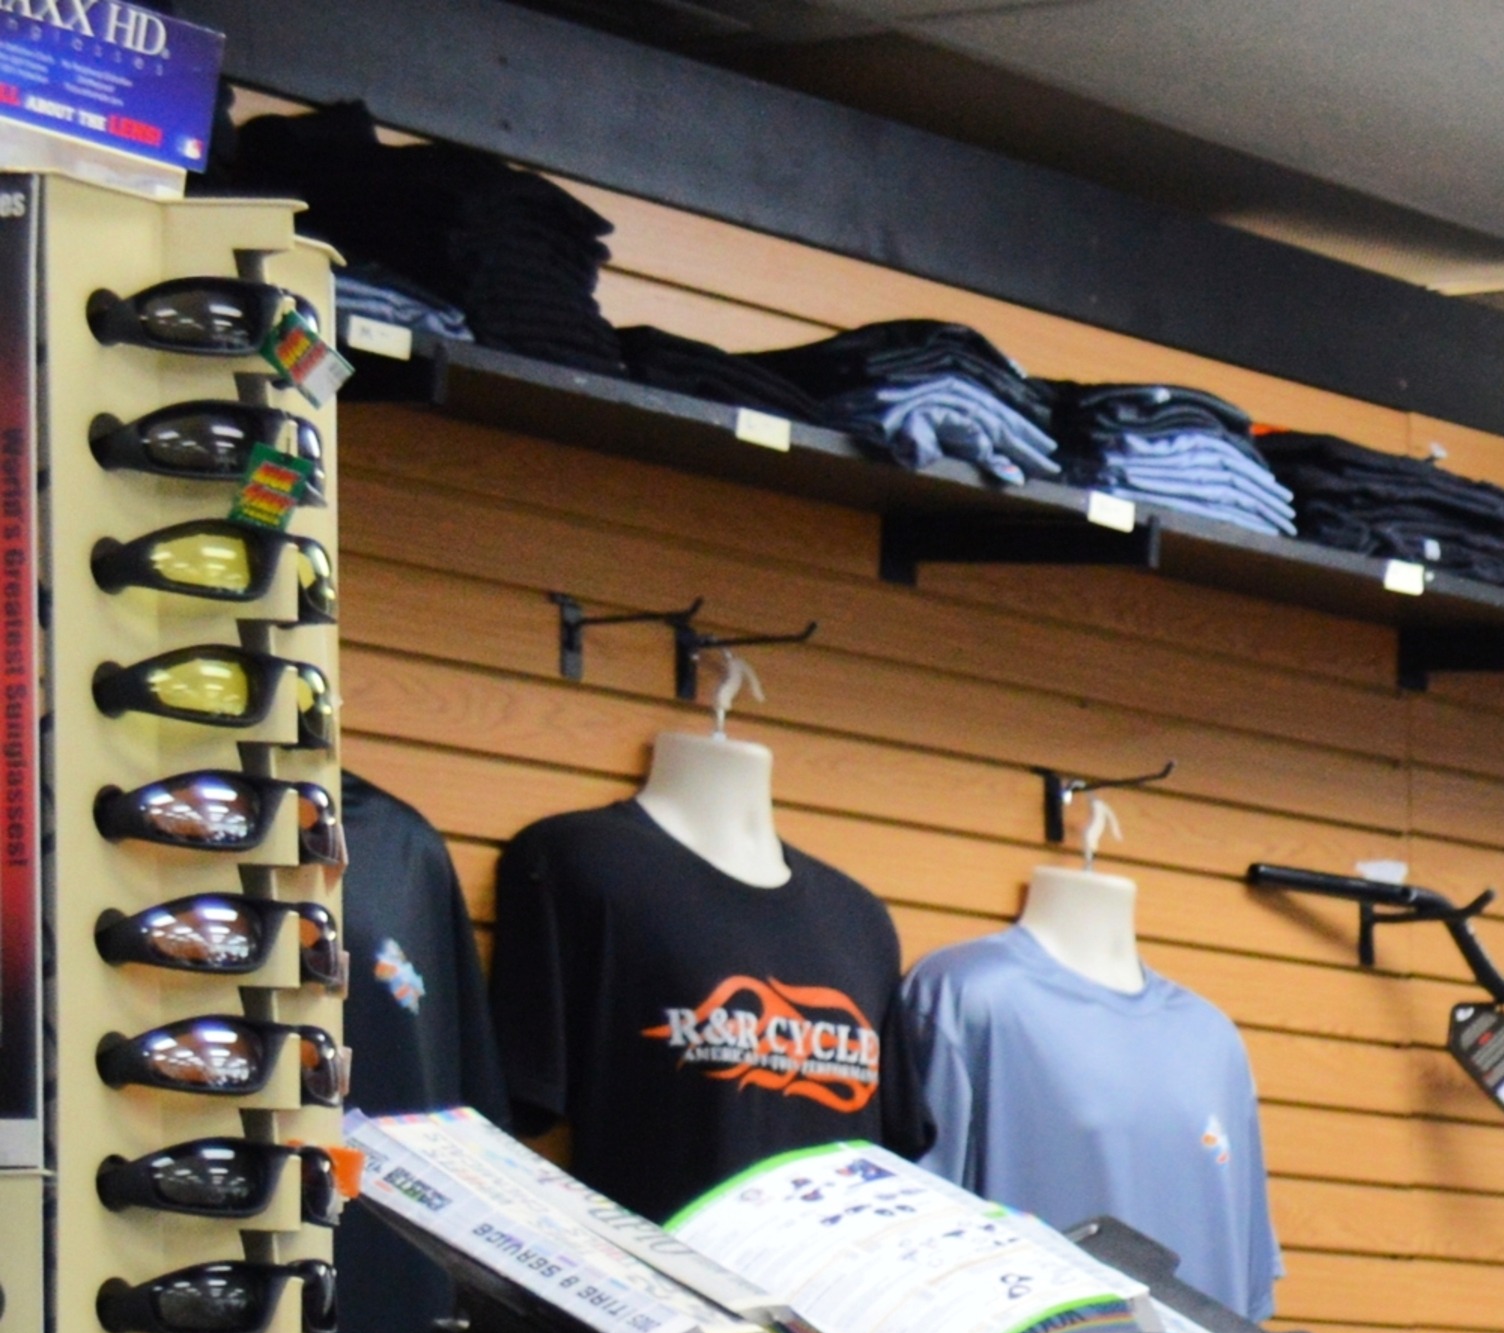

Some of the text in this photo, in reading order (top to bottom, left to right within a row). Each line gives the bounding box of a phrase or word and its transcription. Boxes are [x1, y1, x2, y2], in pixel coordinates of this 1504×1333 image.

[3, 548, 26, 676] Greatest
[665, 1006, 880, 1066] R&R CYCLE
[472, 1222, 564, 1279] SERVICE
[577, 1283, 625, 1319] TIRE
